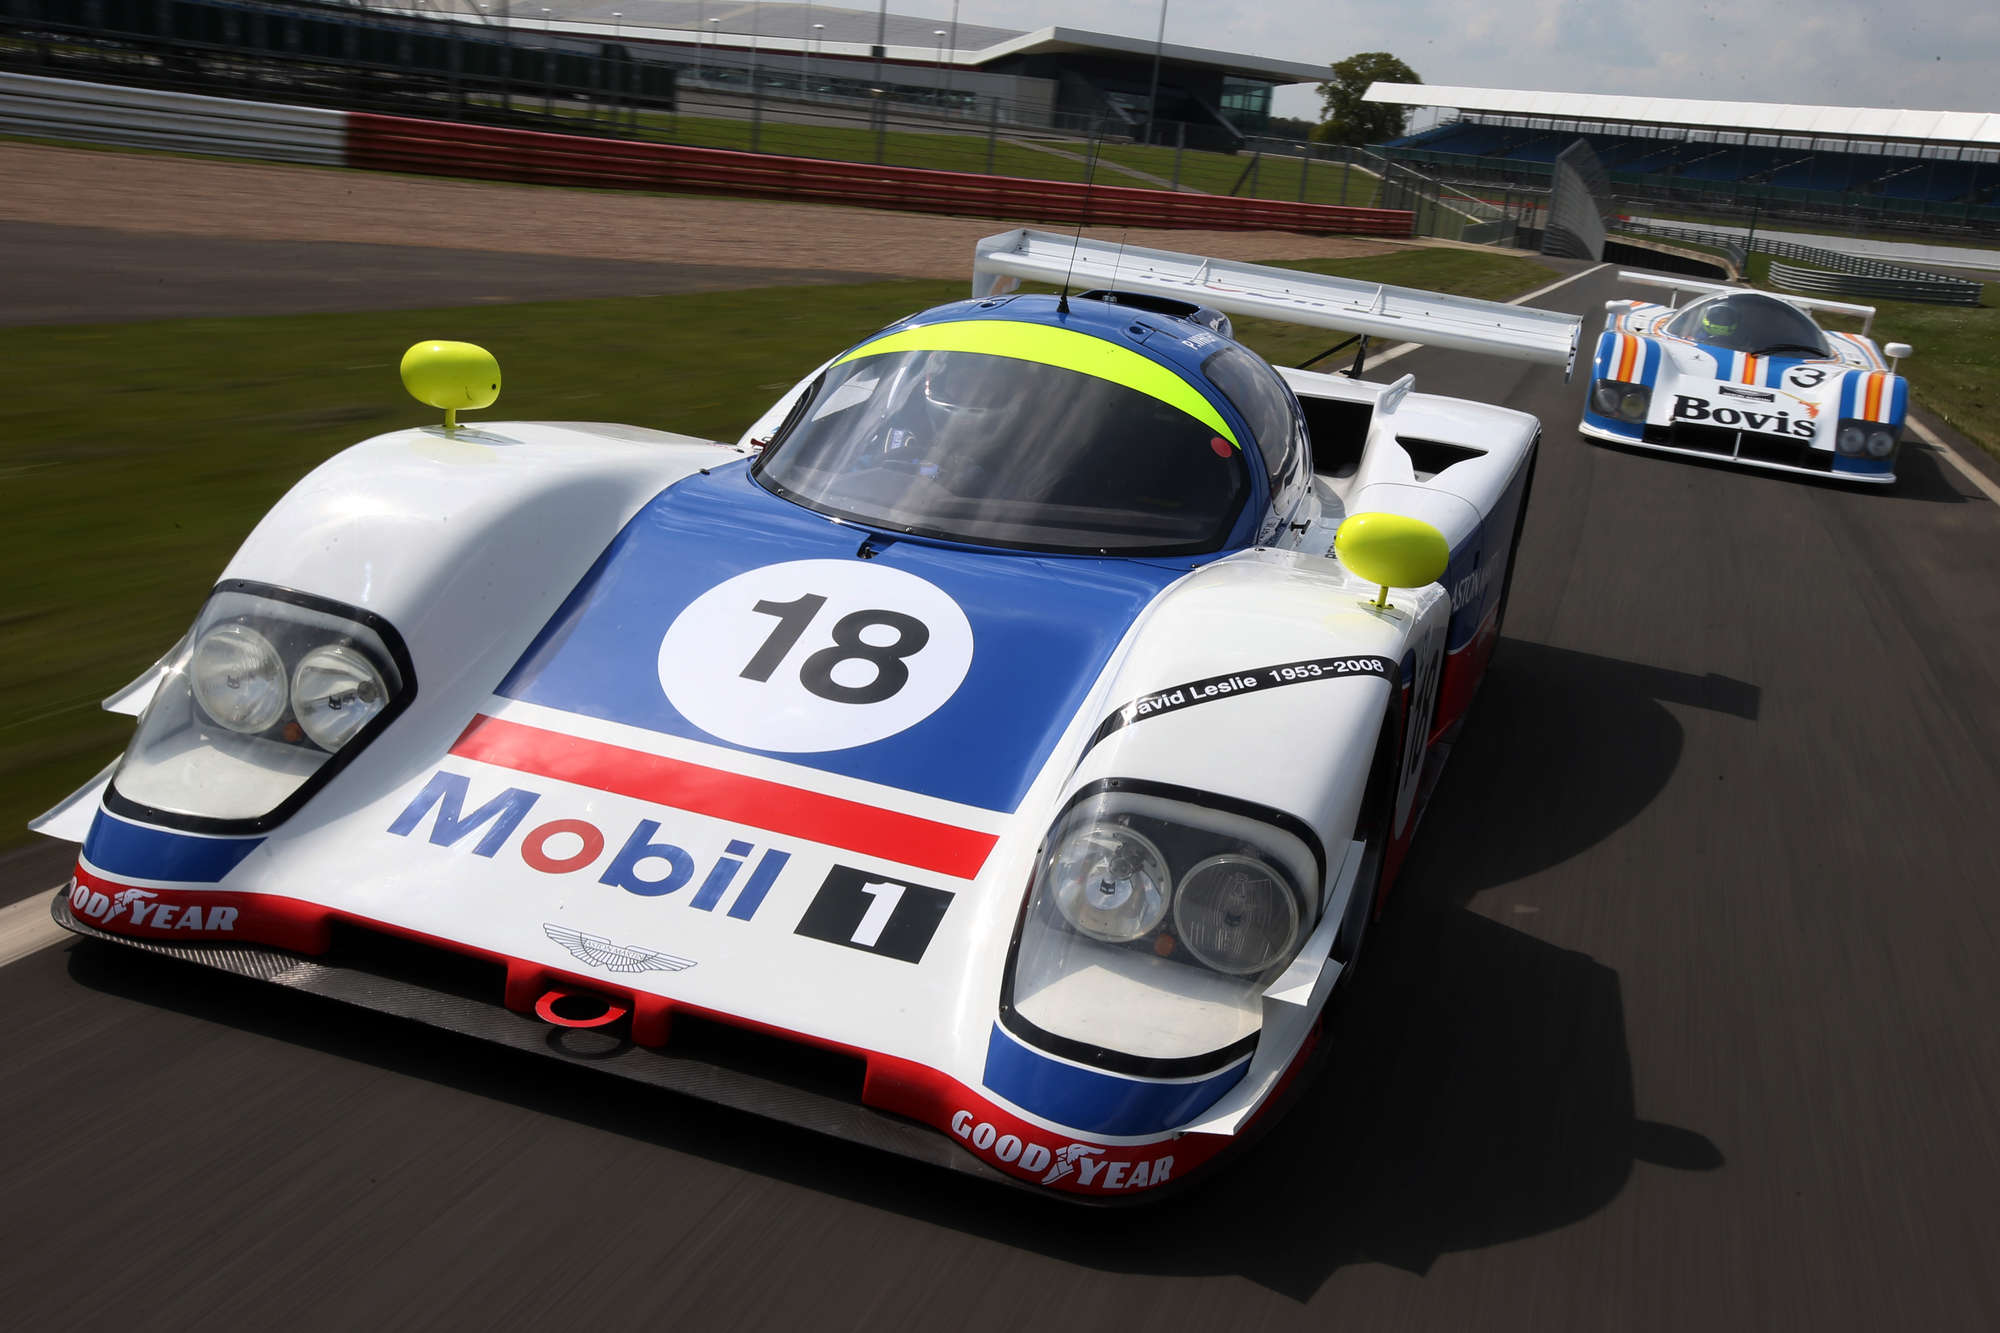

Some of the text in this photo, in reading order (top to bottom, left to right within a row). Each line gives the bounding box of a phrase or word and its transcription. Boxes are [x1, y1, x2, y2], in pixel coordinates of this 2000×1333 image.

[1790, 366, 1827, 388] 3
[1673, 394, 1816, 438] Bovis
[740, 593, 930, 704] 18
[1190, 675, 1257, 699] Leslie
[1269, 658, 1384, 682] 1953-2008
[387, 770, 907, 947] Mobil 1
